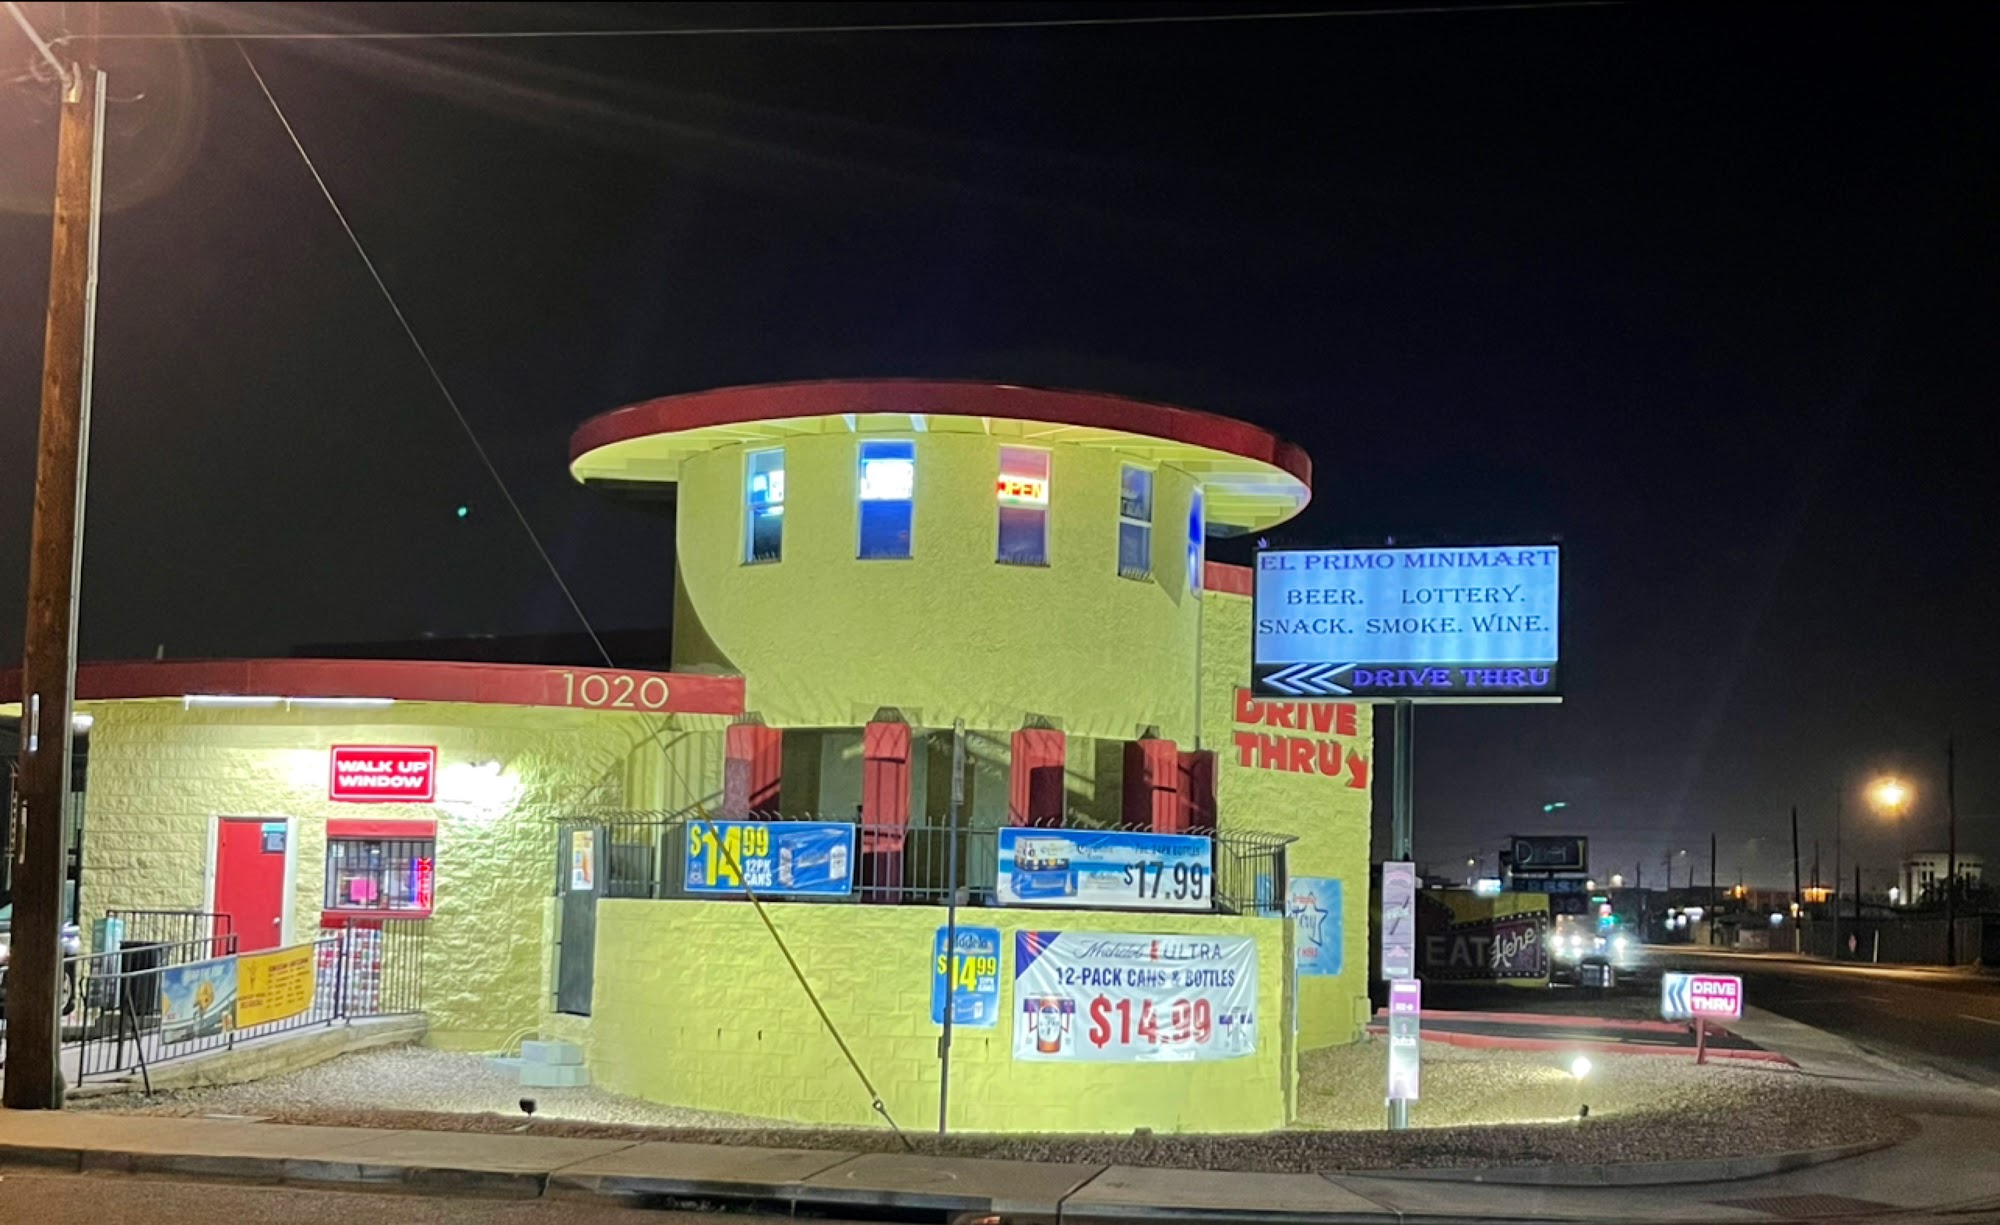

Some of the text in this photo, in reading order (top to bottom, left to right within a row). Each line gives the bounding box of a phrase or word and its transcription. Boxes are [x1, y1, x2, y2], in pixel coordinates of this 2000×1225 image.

[1260, 550, 1557, 571] EL PRIMO MINIMART
[1286, 584, 1526, 606] BEER. LOTTERY.
[1258, 614, 1550, 635] SNACK. SMOKE. WINE.
[1352, 666, 1551, 688] DRIVE THRU
[563, 672, 669, 709] 1020
[1234, 687, 1358, 737] DRIVE
[1233, 730, 1343, 777] THRU
[337, 760, 428, 773] WALK UP
[338, 775, 425, 788] WINDOW
[1123, 860, 1203, 900] $17.99
[1426, 927, 1537, 969] EAT Here
[1185, 969, 1236, 987] BOTTLES
[1692, 981, 1737, 996] DRIVE
[1692, 996, 1736, 1012] THRU
